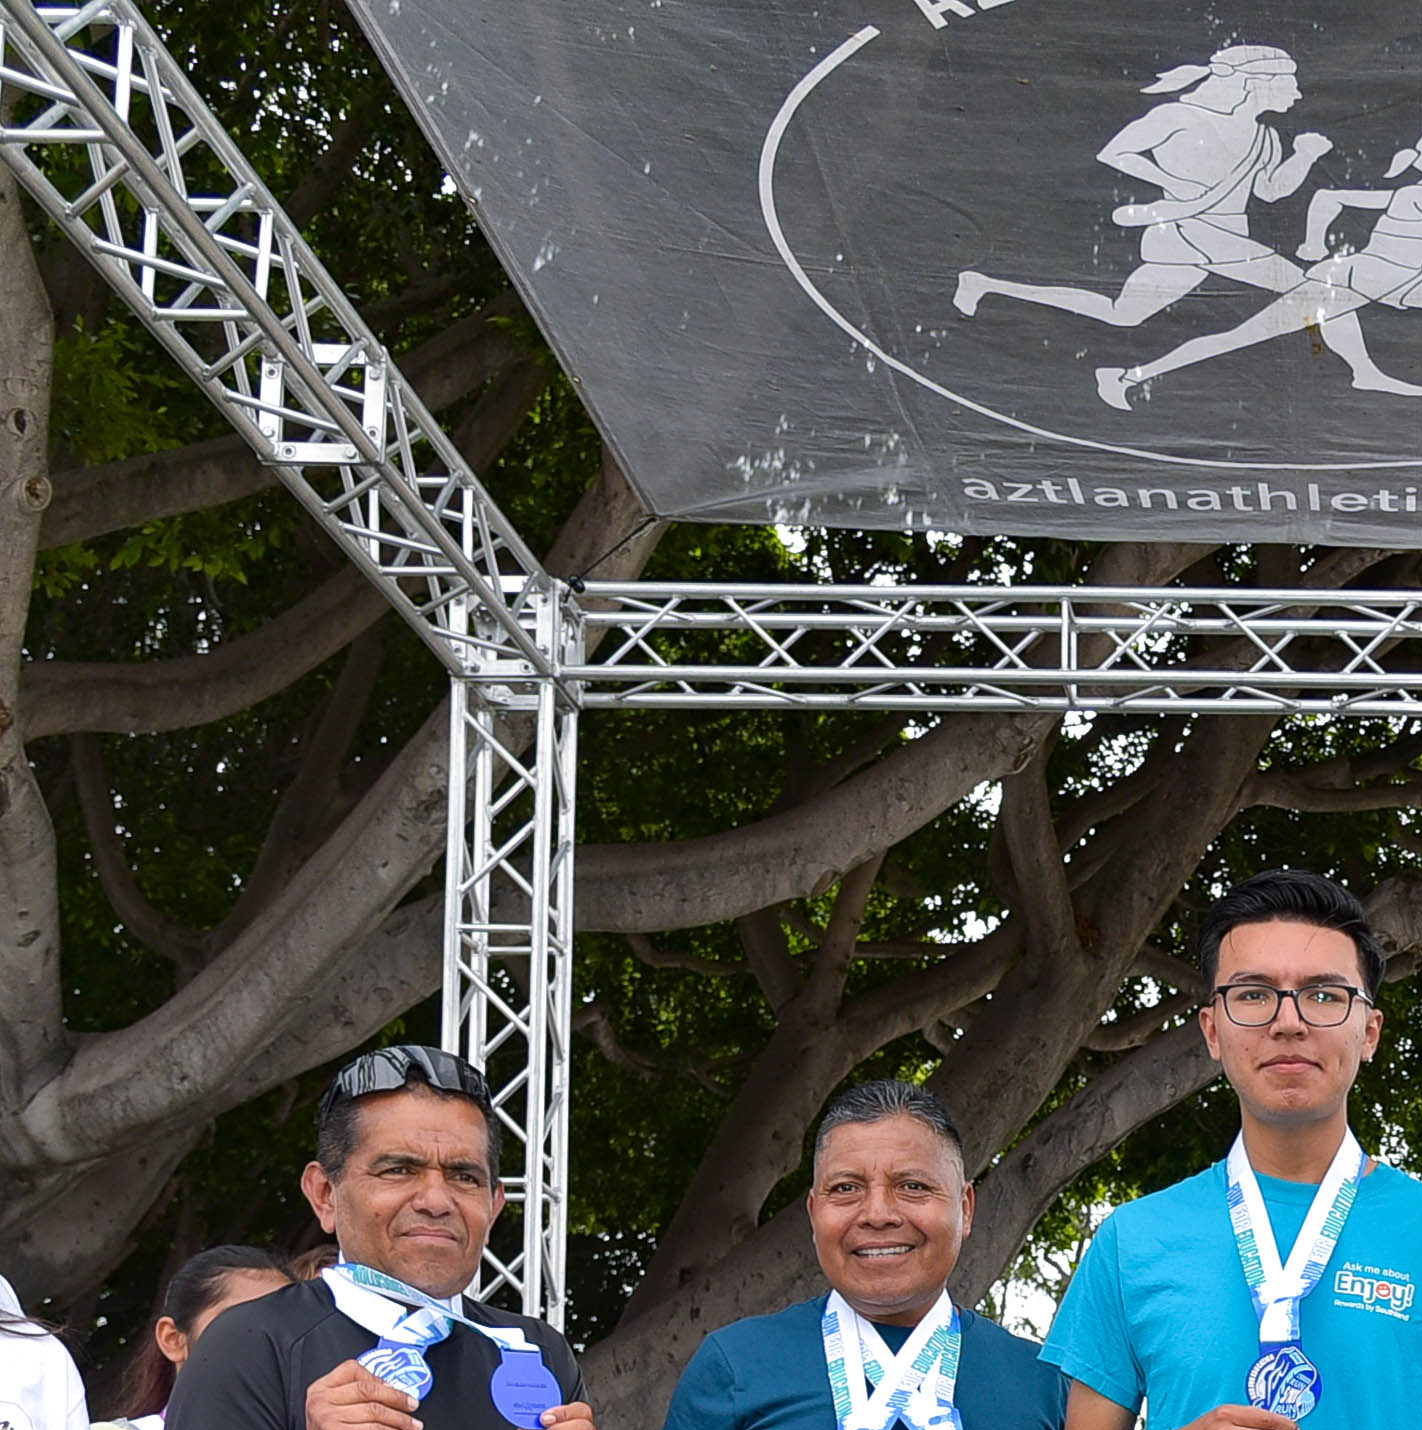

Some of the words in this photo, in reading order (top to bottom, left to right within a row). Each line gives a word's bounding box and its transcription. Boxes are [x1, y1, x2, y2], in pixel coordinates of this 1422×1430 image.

[1226, 1181, 1245, 1209] RUN
[1236, 1228, 1266, 1286] EDUCATION
[1300, 1260, 1326, 1282] RUN
[1319, 1178, 1358, 1241] EDUCATION
[1334, 1271, 1415, 1311] Enjoy!
[1343, 1261, 1362, 1272] Ask
[1364, 1265, 1380, 1274] me
[1382, 1268, 1410, 1282] about
[824, 1310, 840, 1337] RUN
[829, 1357, 853, 1418] EDUCATION
[885, 1388, 913, 1409] RUN
[911, 1325, 948, 1375] EDUCATION
